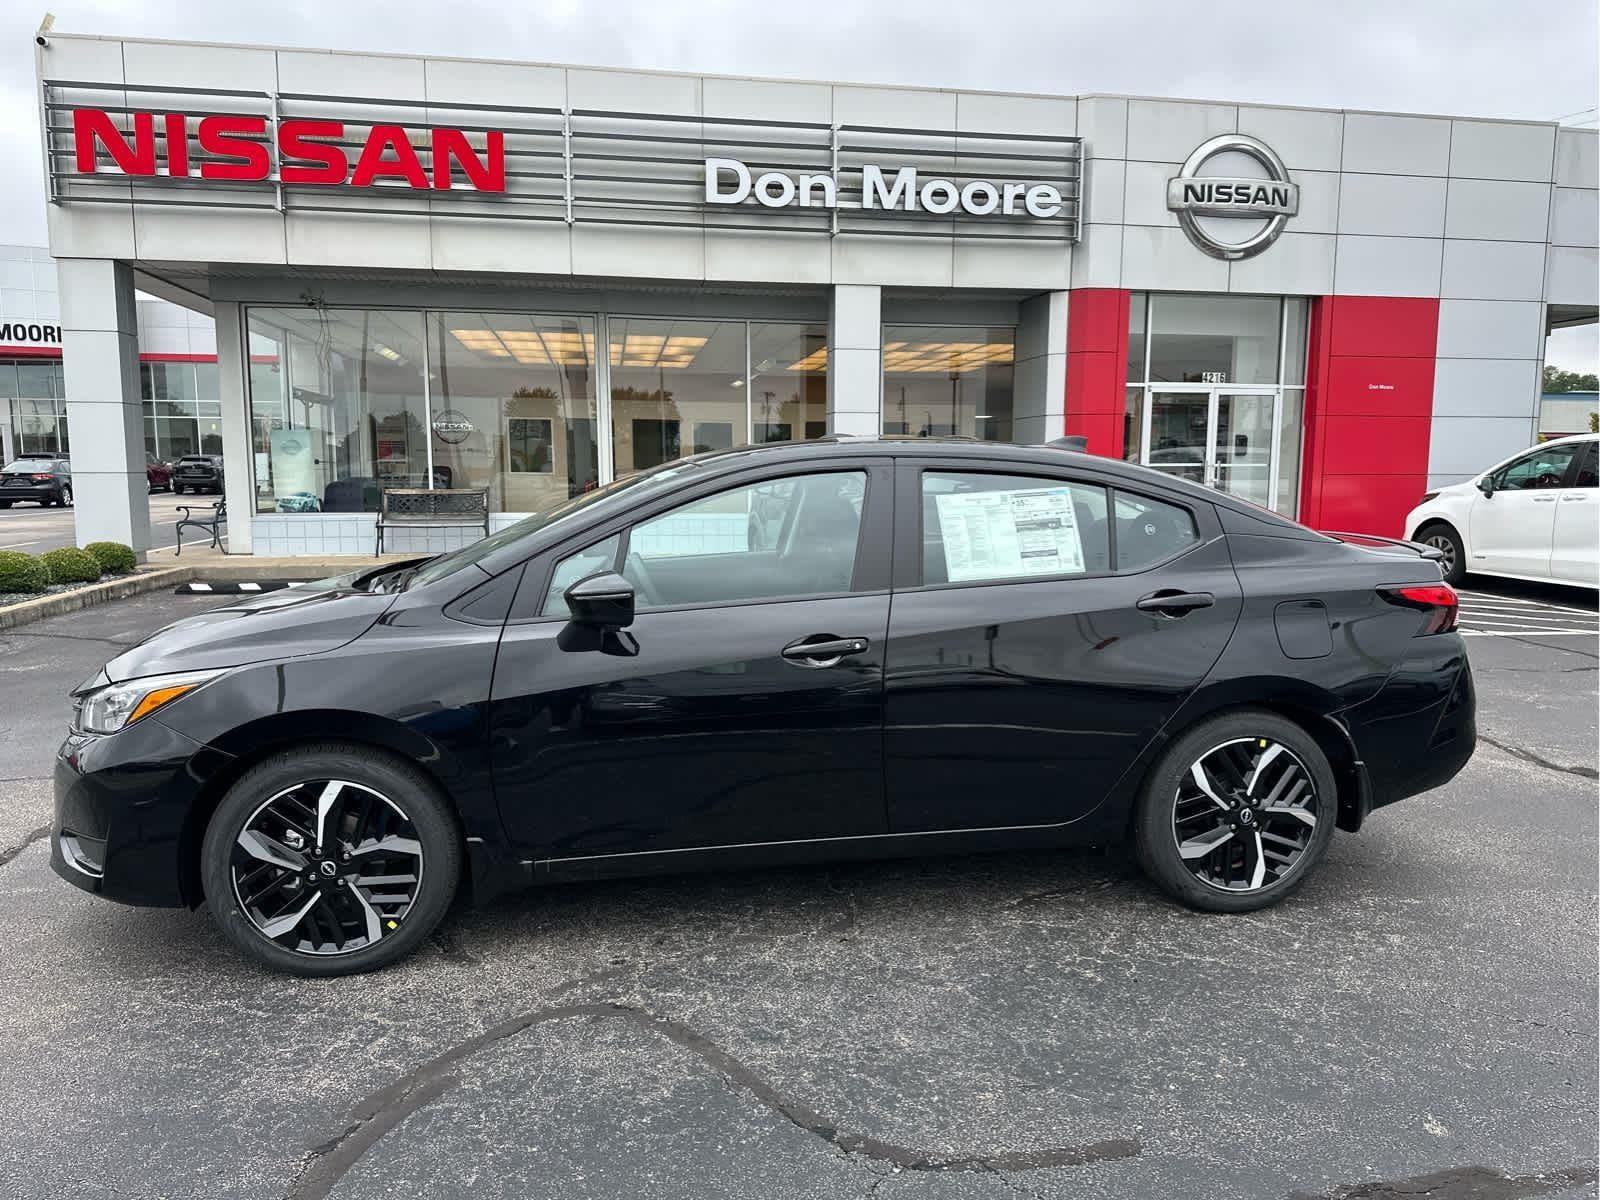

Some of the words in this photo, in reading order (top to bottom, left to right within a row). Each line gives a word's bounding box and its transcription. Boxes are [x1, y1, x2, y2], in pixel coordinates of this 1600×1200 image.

[73, 108, 505, 193] NISSAN
[705, 157, 836, 207] Don
[863, 164, 1063, 218] Moore
[1184, 184, 1288, 207] NISSAN
[1202, 372, 1225, 383] 4216
[435, 422, 470, 431] NISSAN
